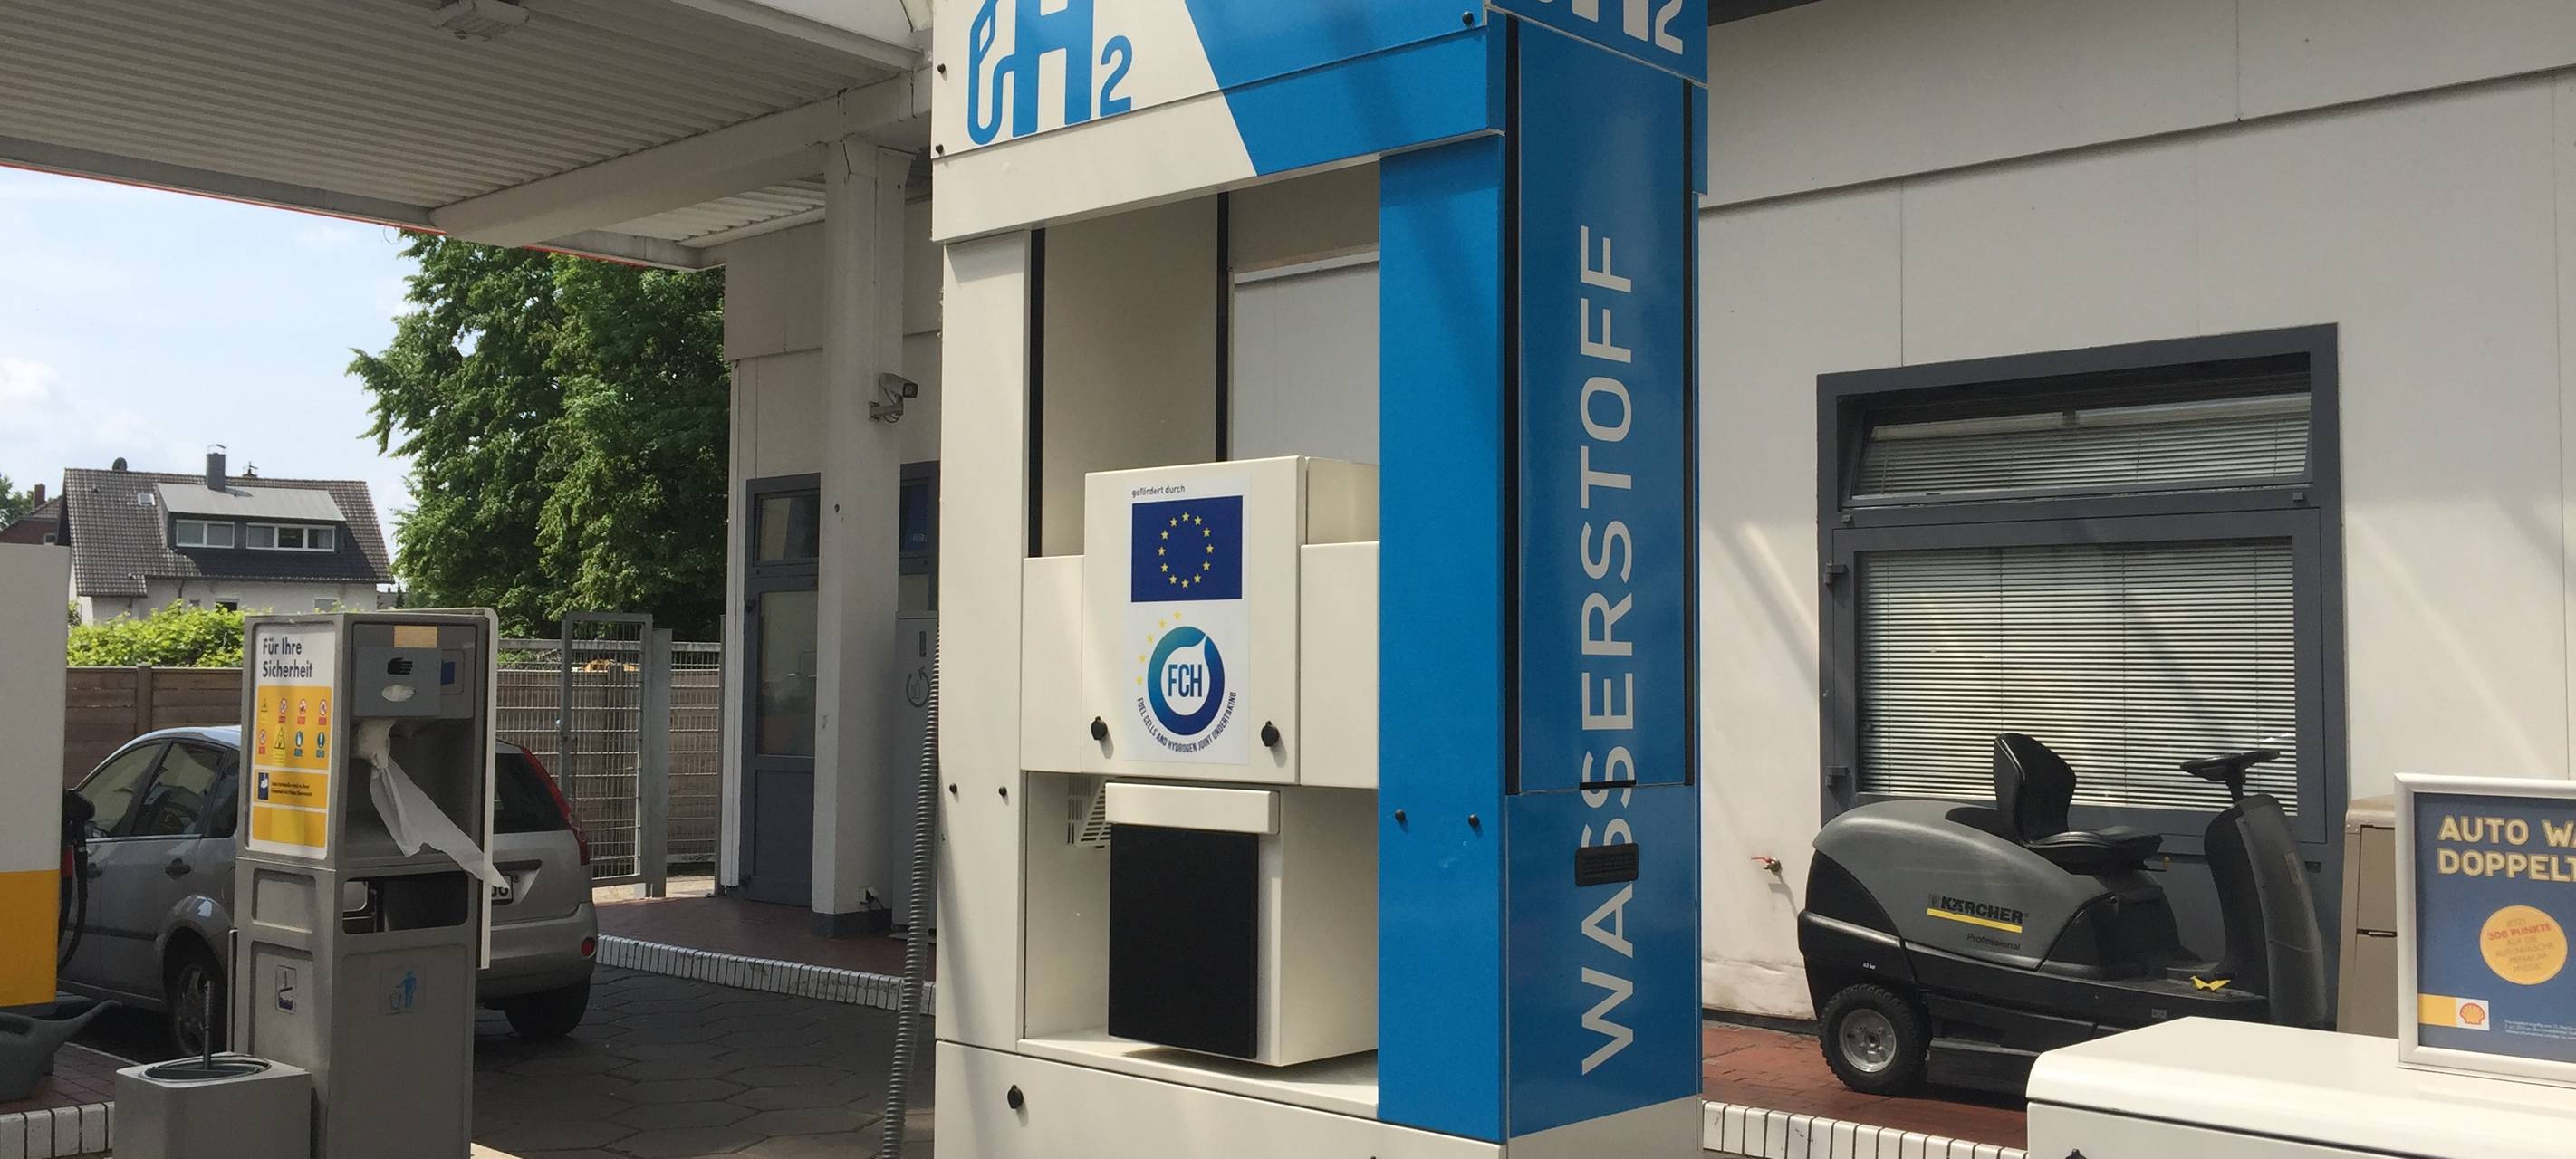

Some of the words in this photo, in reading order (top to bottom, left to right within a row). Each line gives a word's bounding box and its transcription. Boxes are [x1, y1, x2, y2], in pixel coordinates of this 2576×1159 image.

[1131, 486, 1164, 498] gefördert
[1165, 485, 1186, 494] durch
[263, 637, 279, 655] Für
[282, 637, 303, 655] Ihre
[262, 659, 313, 678] Sicherheit
[1168, 664, 1203, 697] FCH
[1137, 697, 1148, 717] FUEL
[1143, 715, 1158, 737] CELLS
[1156, 733, 1168, 747] AND
[1167, 741, 1197, 753] HYDROGEN
[1197, 734, 1213, 751] JOINT
[1211, 691, 1237, 740] UNDERTAKING
[2437, 814, 2530, 846] AUTO
[2488, 930, 2508, 941] 300
[2510, 923, 2552, 936] PUNKTE
[1966, 933, 2022, 951] Professional
